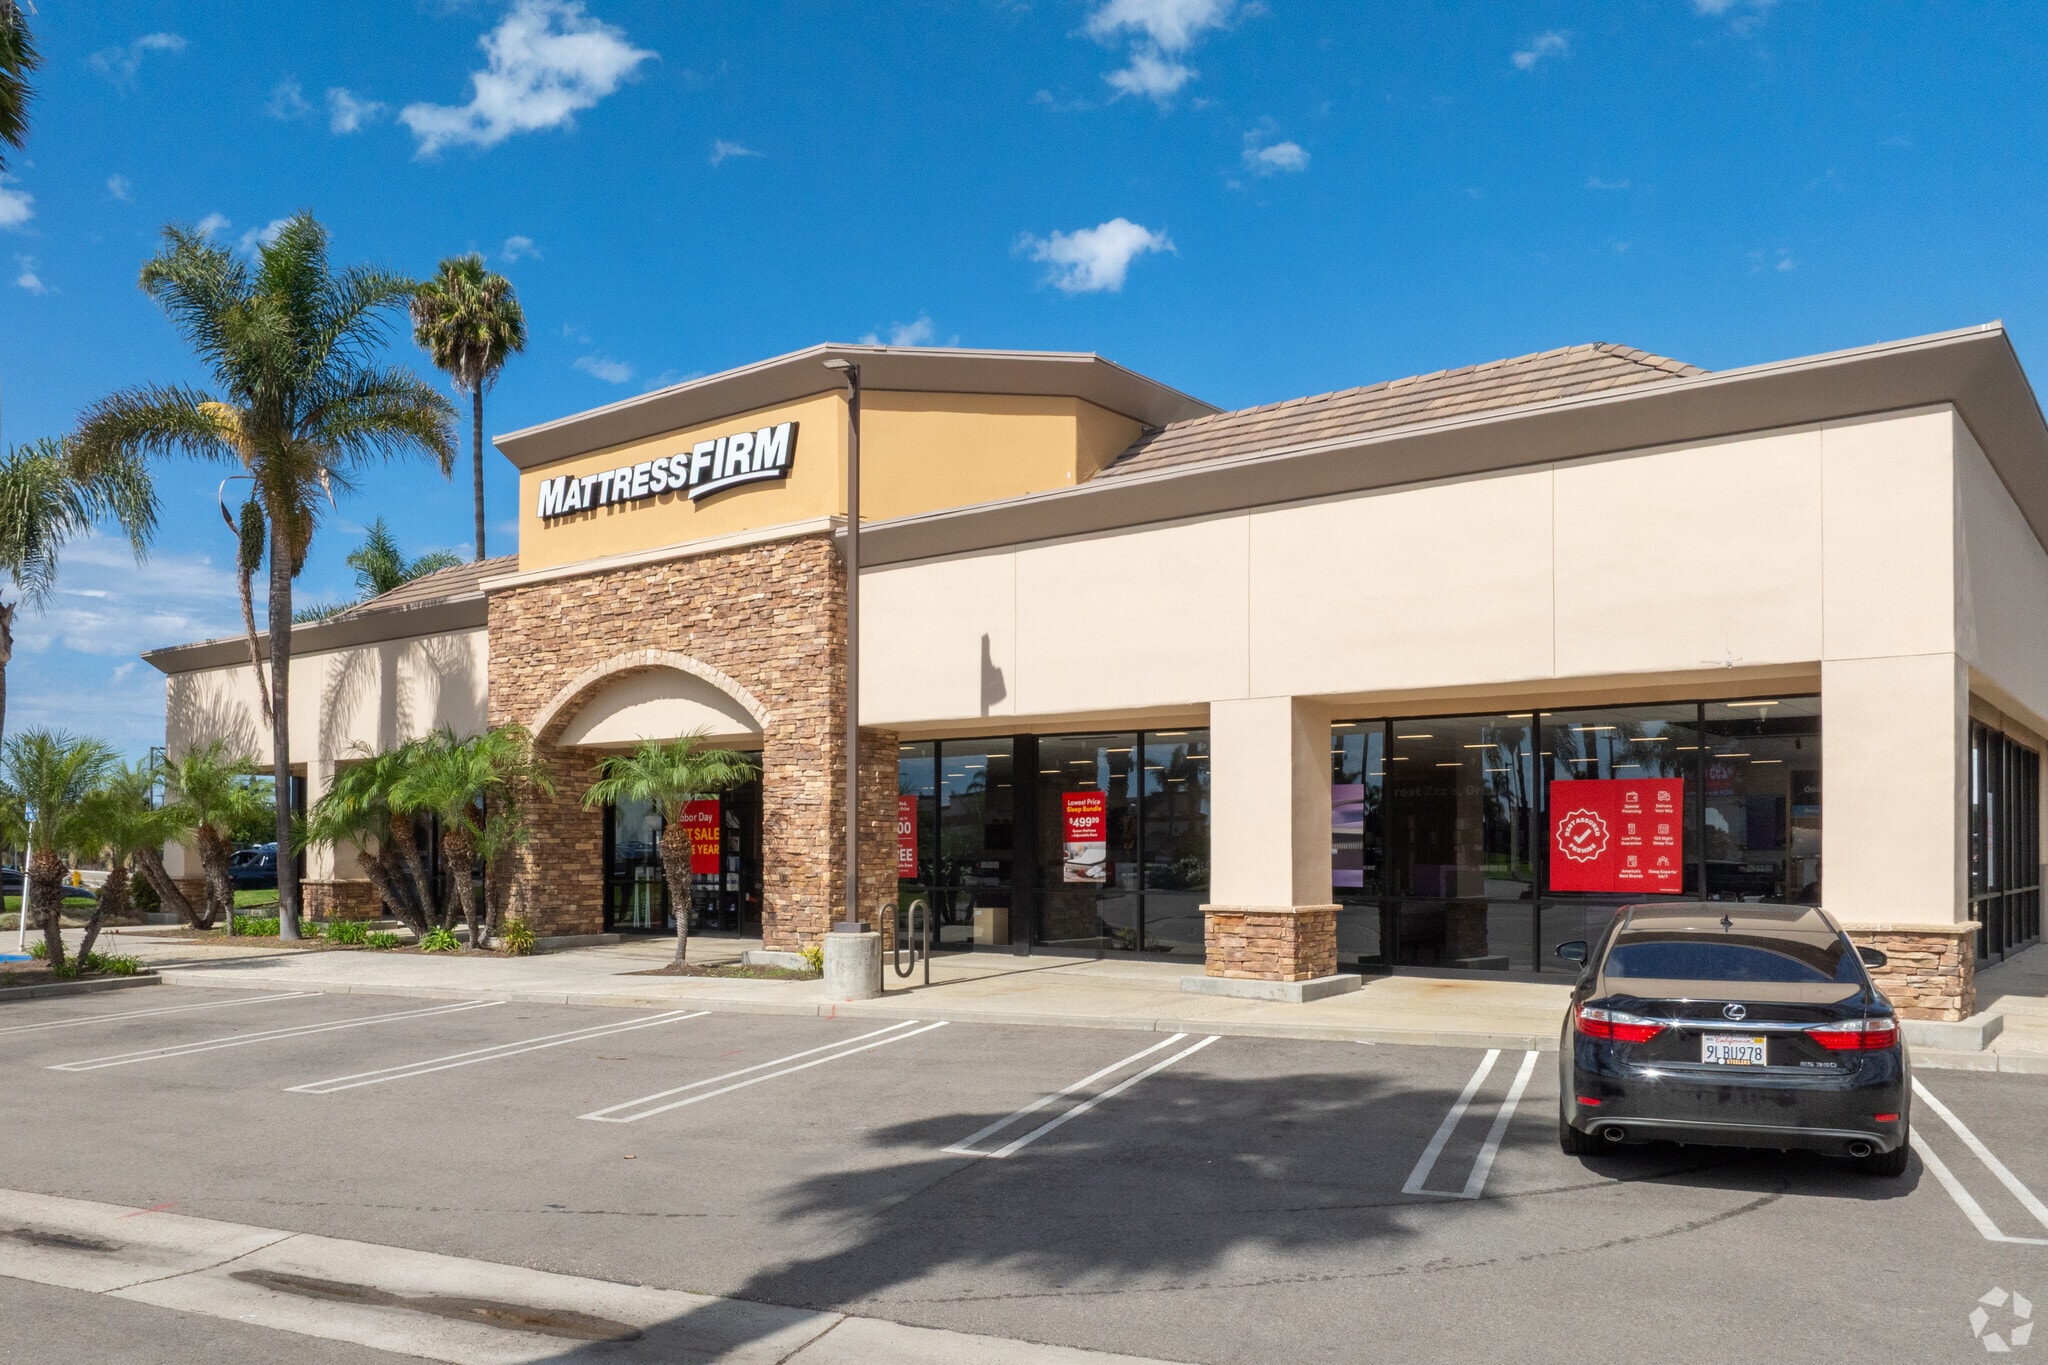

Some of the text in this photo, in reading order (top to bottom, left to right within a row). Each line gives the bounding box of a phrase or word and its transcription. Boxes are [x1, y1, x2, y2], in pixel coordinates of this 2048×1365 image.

[1066, 806, 1082, 814] Sleep
[698, 812, 713, 824] Day
[694, 827, 720, 841] SALE
[697, 844, 720, 855] YEAR
[1568, 843, 1597, 854] PROMISE
[1715, 1036, 1751, 1045] California
[1706, 1045, 1762, 1061] 9LBU978
